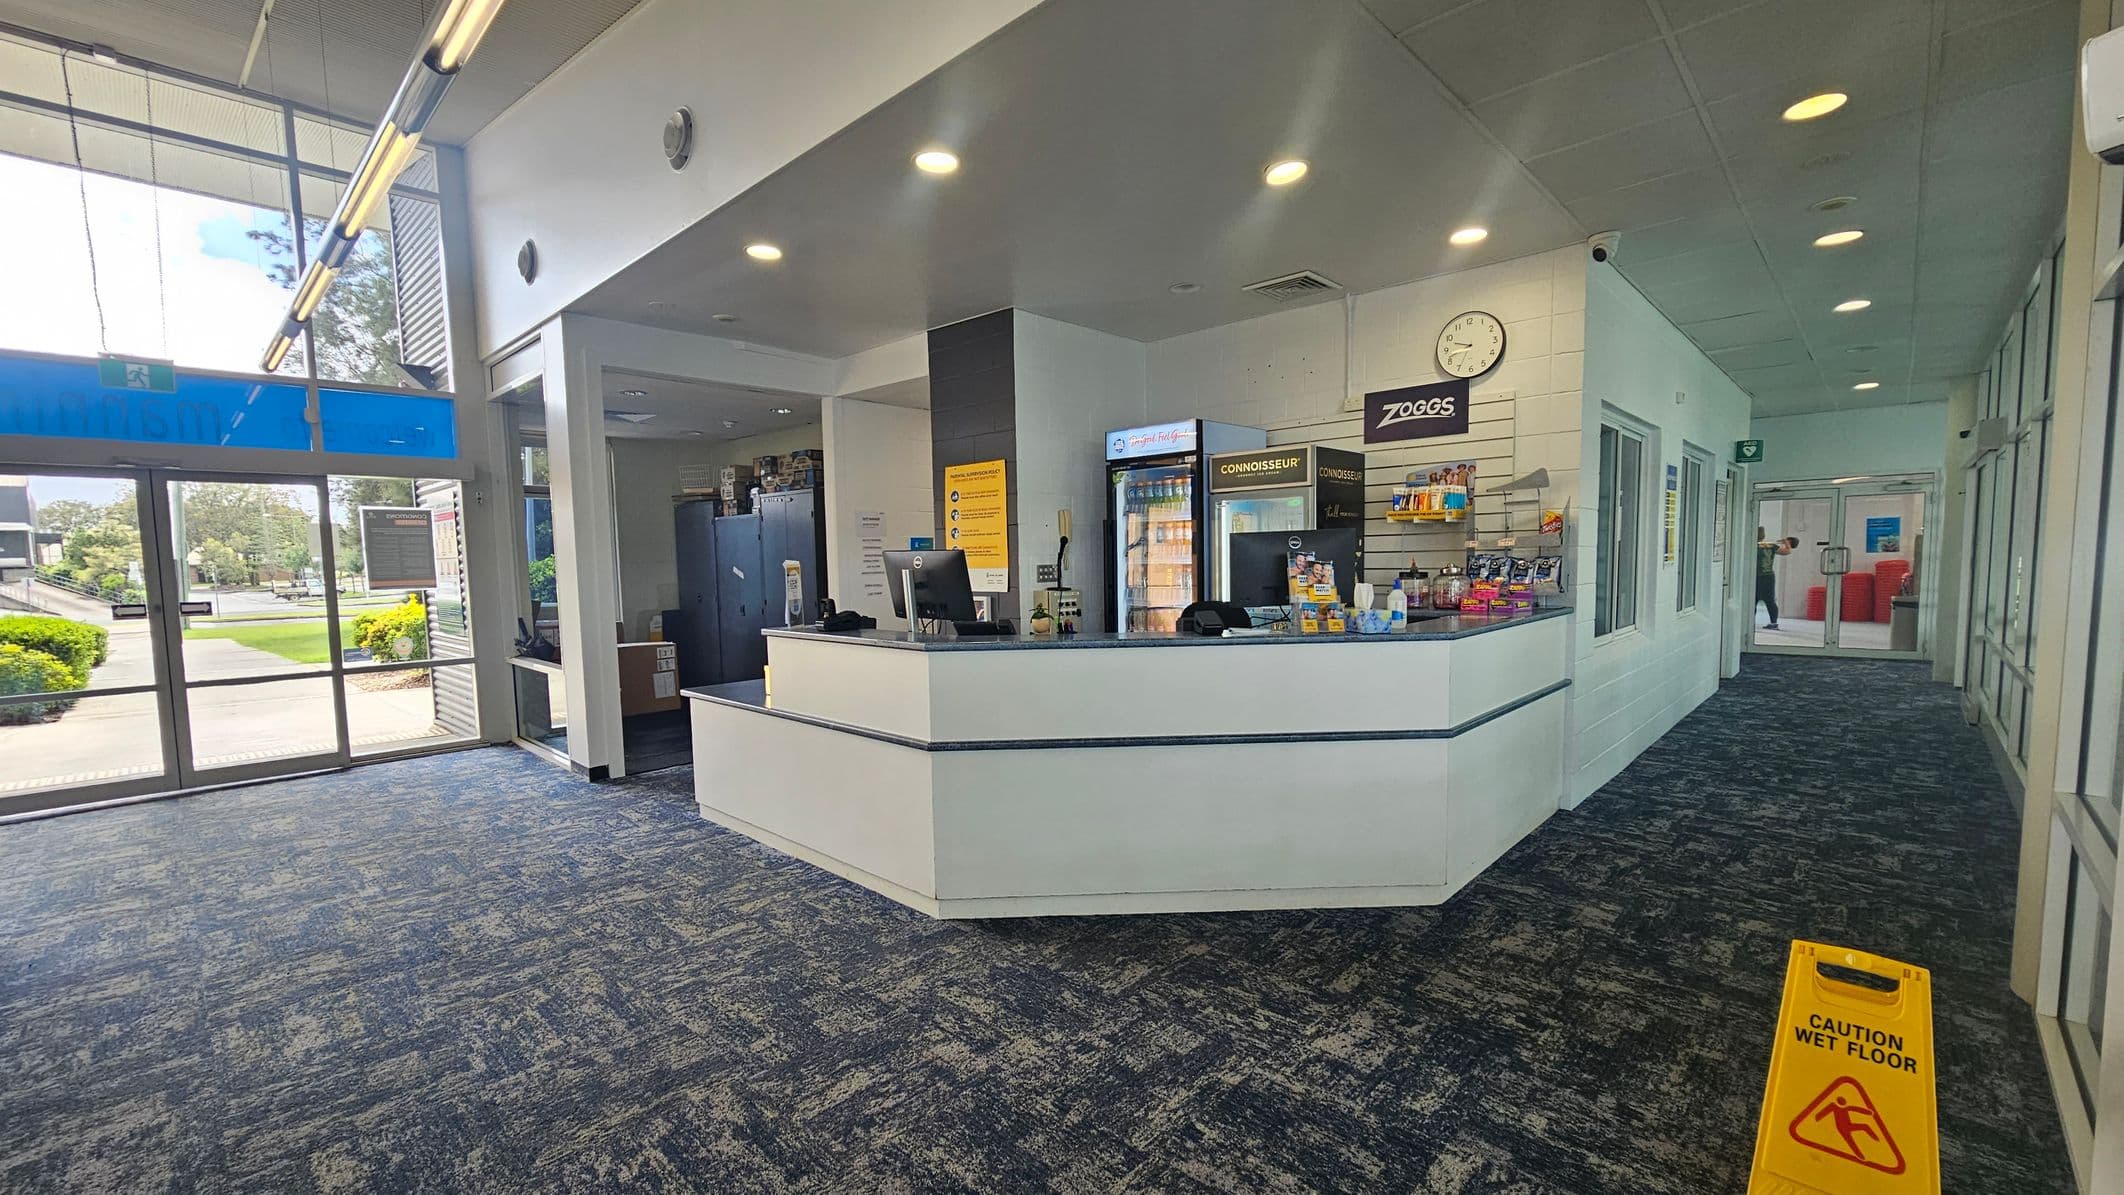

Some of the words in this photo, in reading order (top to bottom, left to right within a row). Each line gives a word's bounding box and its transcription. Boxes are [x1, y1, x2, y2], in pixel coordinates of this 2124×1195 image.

[1466, 317, 1474, 325] 12
[1455, 323, 1462, 331] 11
[1488, 324, 1494, 332] 2
[1446, 334, 1453, 342] 10
[1492, 335, 1498, 343] 3
[1481, 359, 1487, 367] 5
[1468, 365, 1474, 373] 6
[1376, 396, 1456, 430] ZOGGS
[1220, 457, 1299, 474] CONNOISSEUR
[1318, 466, 1362, 481] CONNOISSEUR
[1809, 1013, 1904, 1051] CAUTION
[1795, 1026, 1838, 1051] WET
[1847, 1041, 1917, 1074] FLOOR
